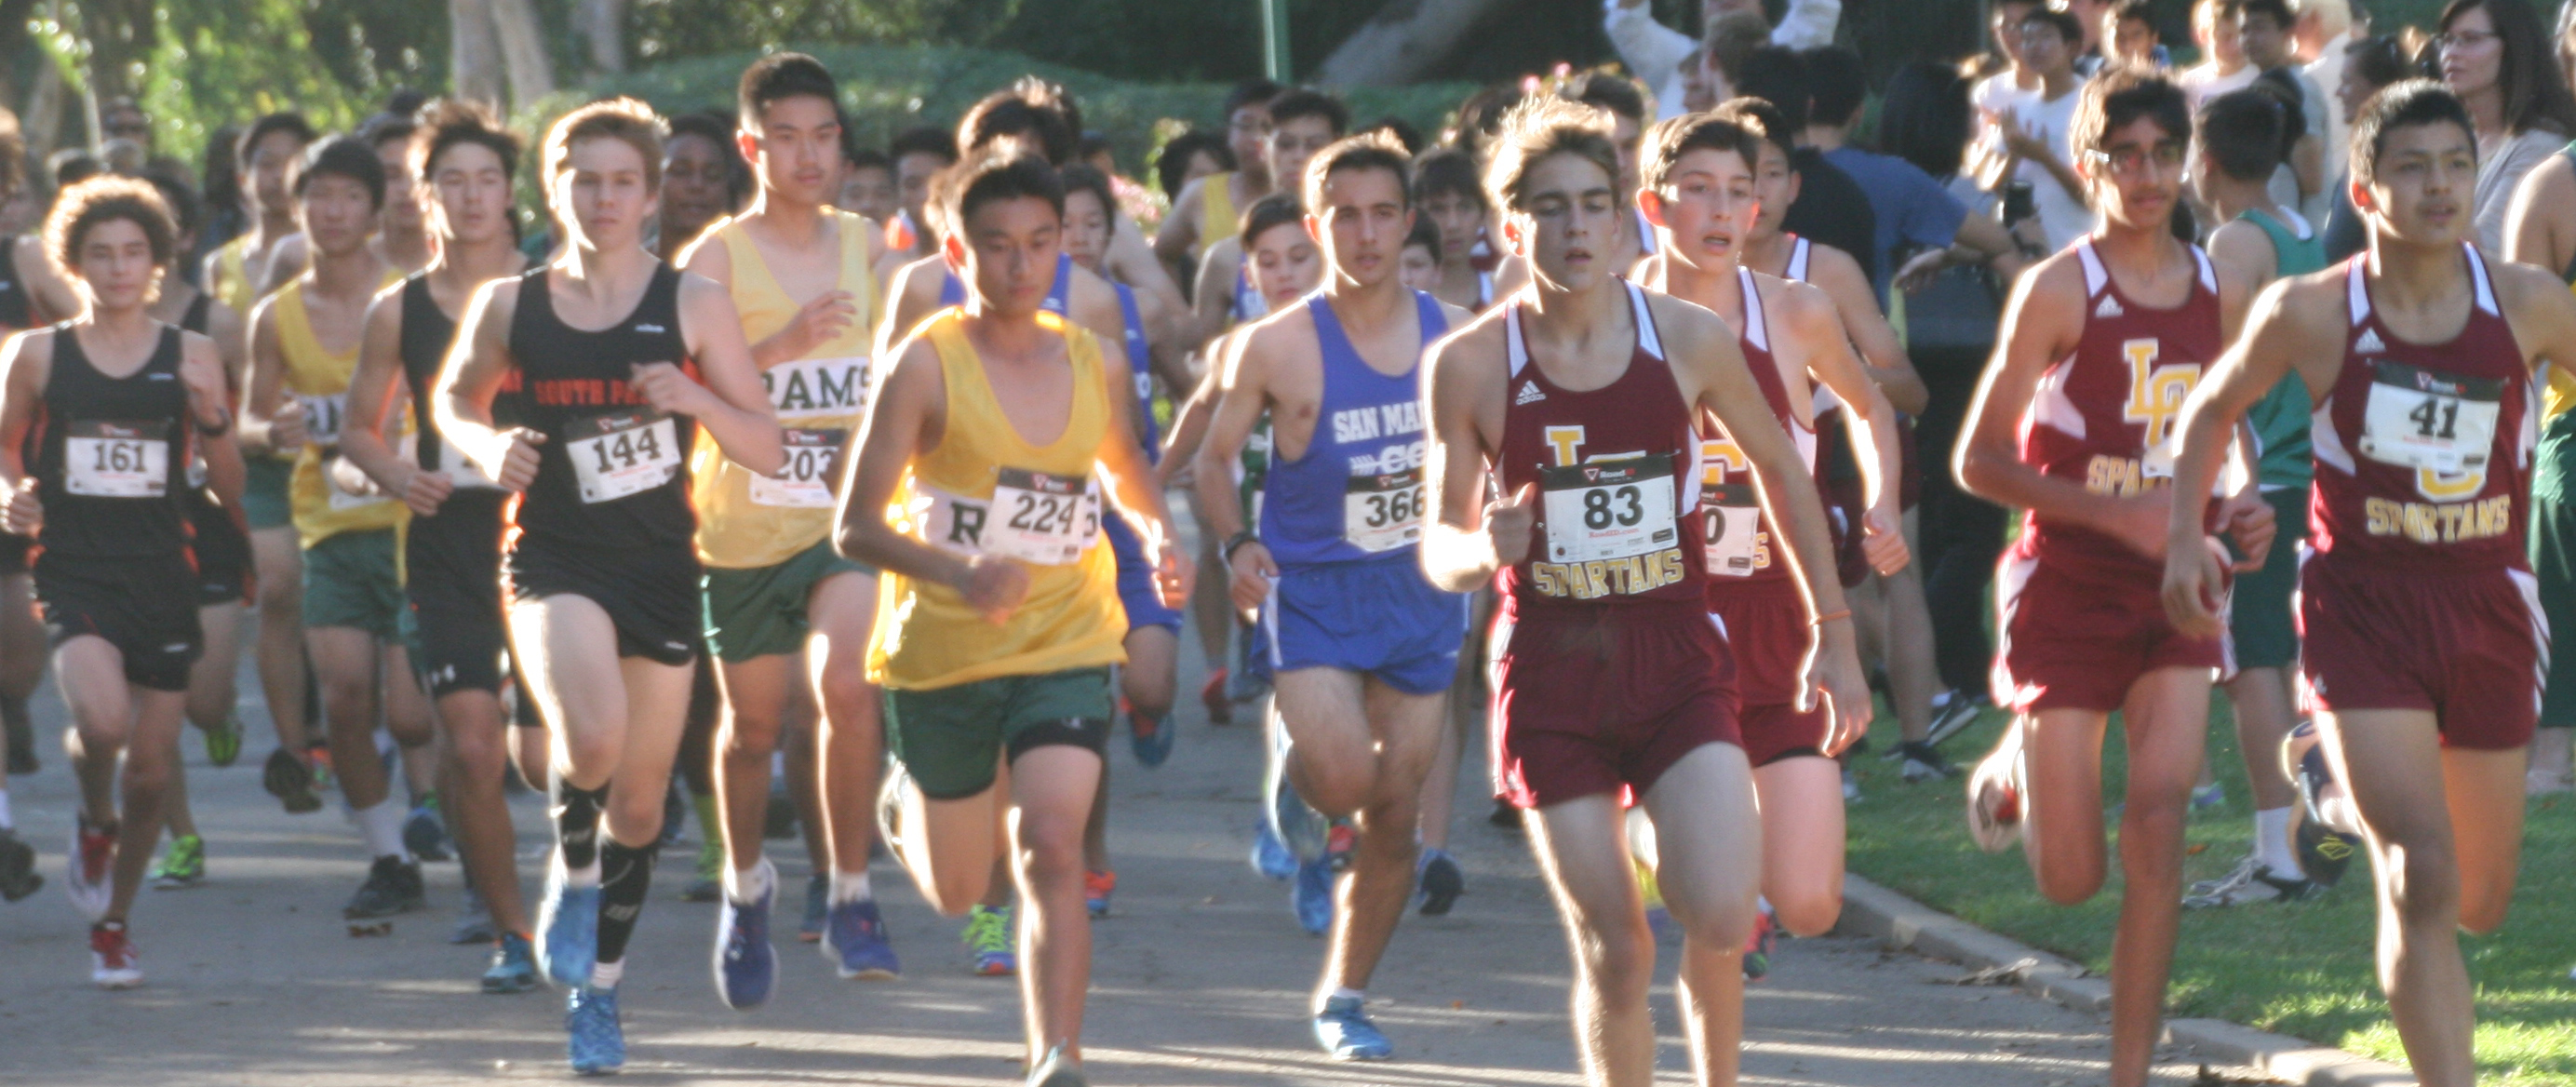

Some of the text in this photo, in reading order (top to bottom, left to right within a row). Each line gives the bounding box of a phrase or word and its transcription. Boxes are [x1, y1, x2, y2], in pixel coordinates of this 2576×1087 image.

[1516, 393, 1546, 405] adidas
[2409, 394, 2460, 439] 41
[1333, 407, 1380, 444] SAN
[93, 441, 147, 472] 161
[593, 427, 662, 474] 144
[1008, 495, 1079, 536] 224
[1364, 486, 1427, 529] 366
[1584, 485, 1644, 530] 83
[1702, 507, 1726, 545] 0
[2366, 494, 2511, 543] SPARTANS
[1532, 548, 1684, 599] SPARTANS
